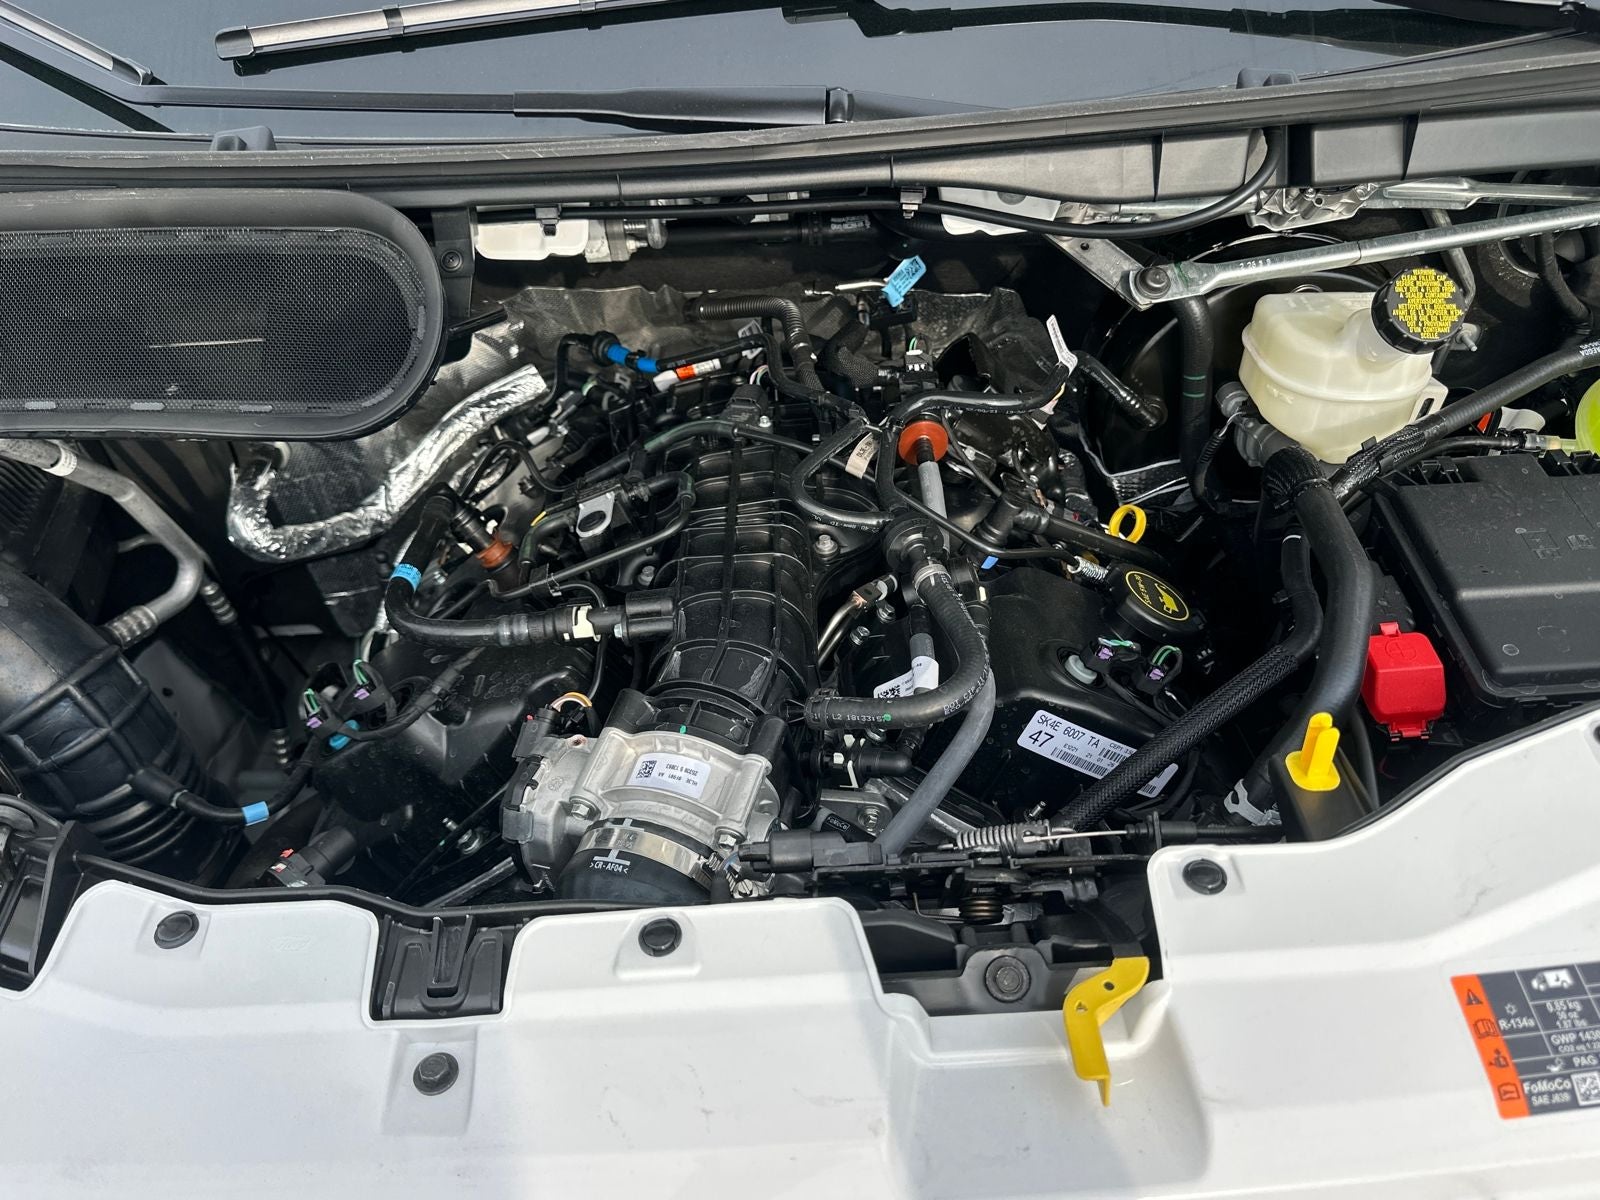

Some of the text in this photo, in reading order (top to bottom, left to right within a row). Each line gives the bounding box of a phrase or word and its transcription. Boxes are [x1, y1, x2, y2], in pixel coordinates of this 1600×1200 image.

[1028, 730, 1055, 748] 47
[1037, 714, 1102, 749] SK4E 6007 TA
[1499, 1015, 1536, 1031] R-134a
[1550, 1032, 1577, 1046] GWP
[1572, 1054, 1598, 1068] PAG
[1522, 1078, 1571, 1095] FoMoCo
